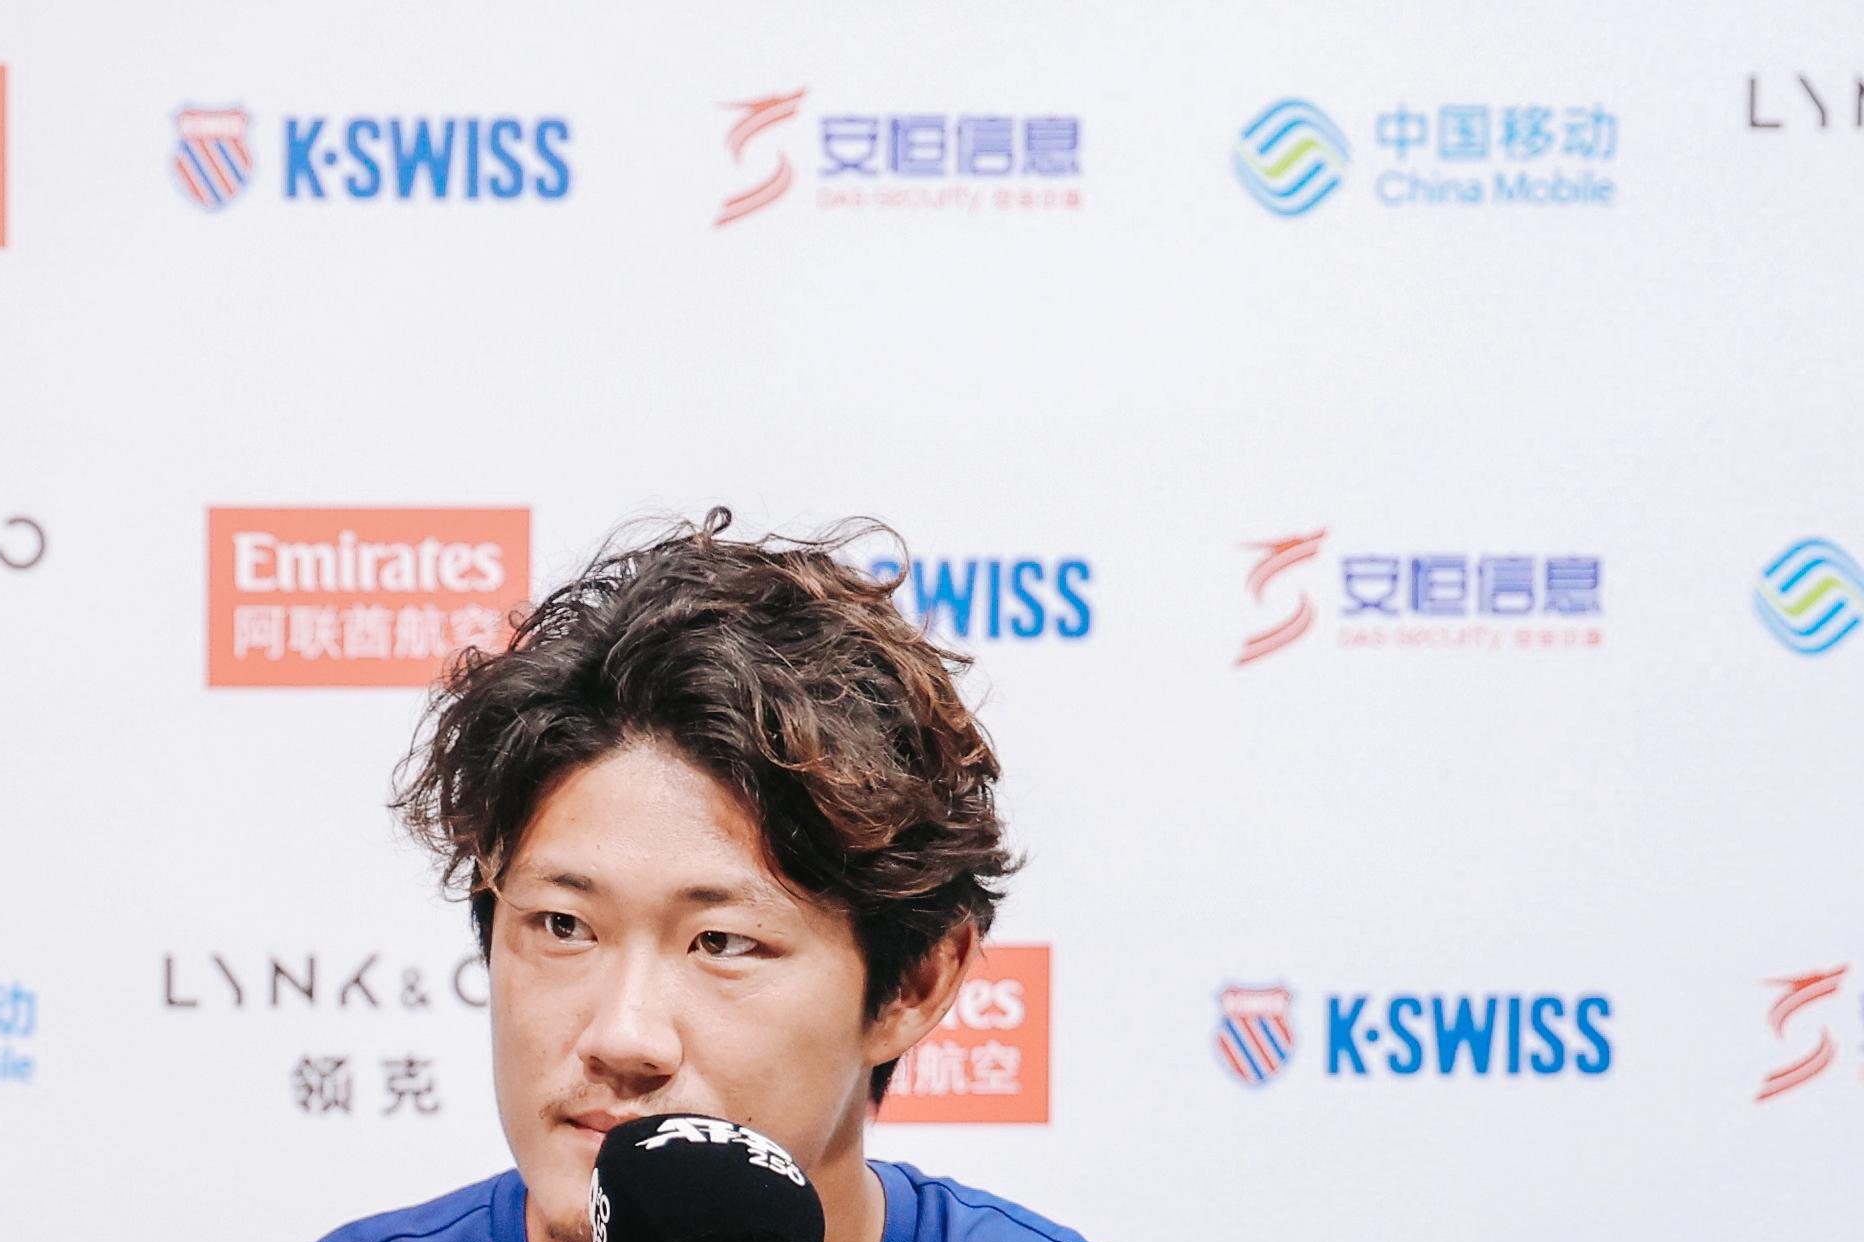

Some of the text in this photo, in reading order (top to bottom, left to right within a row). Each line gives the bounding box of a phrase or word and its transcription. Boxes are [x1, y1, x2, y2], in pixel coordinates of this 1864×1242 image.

[1748, 75, 1864, 130] LY
[820, 115, 1081, 178] 安恒信息
[1376, 105, 1617, 161] 中国移动
[1375, 170, 1616, 206] China Mobile
[233, 530, 505, 592] Emirates
[1342, 555, 1602, 616] 安恒信息
[232, 604, 502, 660] 阿联酋航空
[293, 1056, 440, 1115] 领克
[747, 1148, 806, 1187] 250
